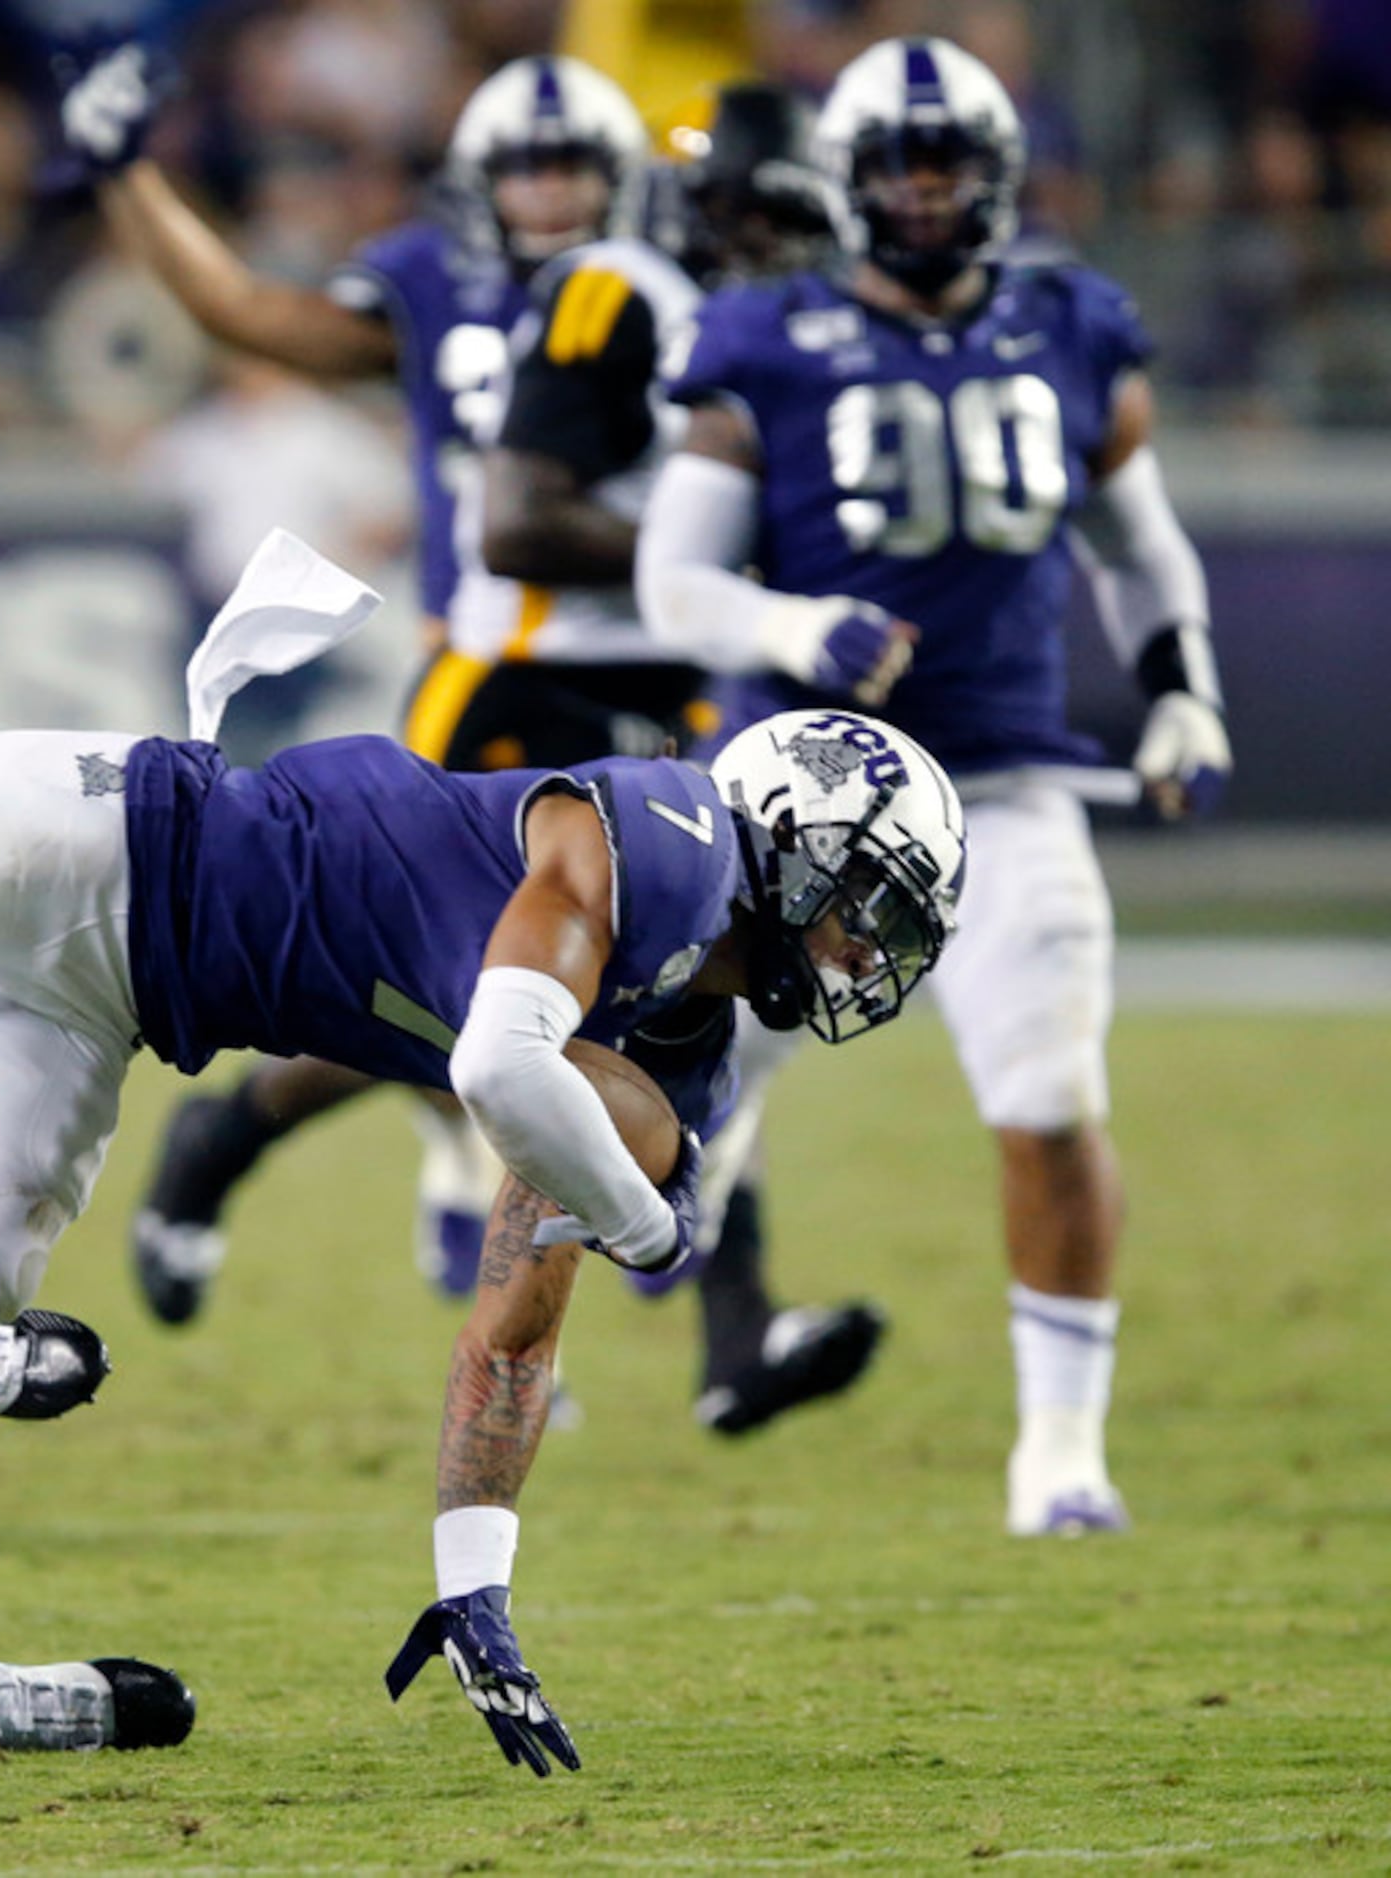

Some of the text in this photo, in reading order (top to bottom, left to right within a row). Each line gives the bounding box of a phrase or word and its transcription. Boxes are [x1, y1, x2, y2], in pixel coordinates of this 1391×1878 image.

[826, 373, 1067, 557] 90
[804, 714, 911, 790] TCU
[643, 797, 714, 846] 7
